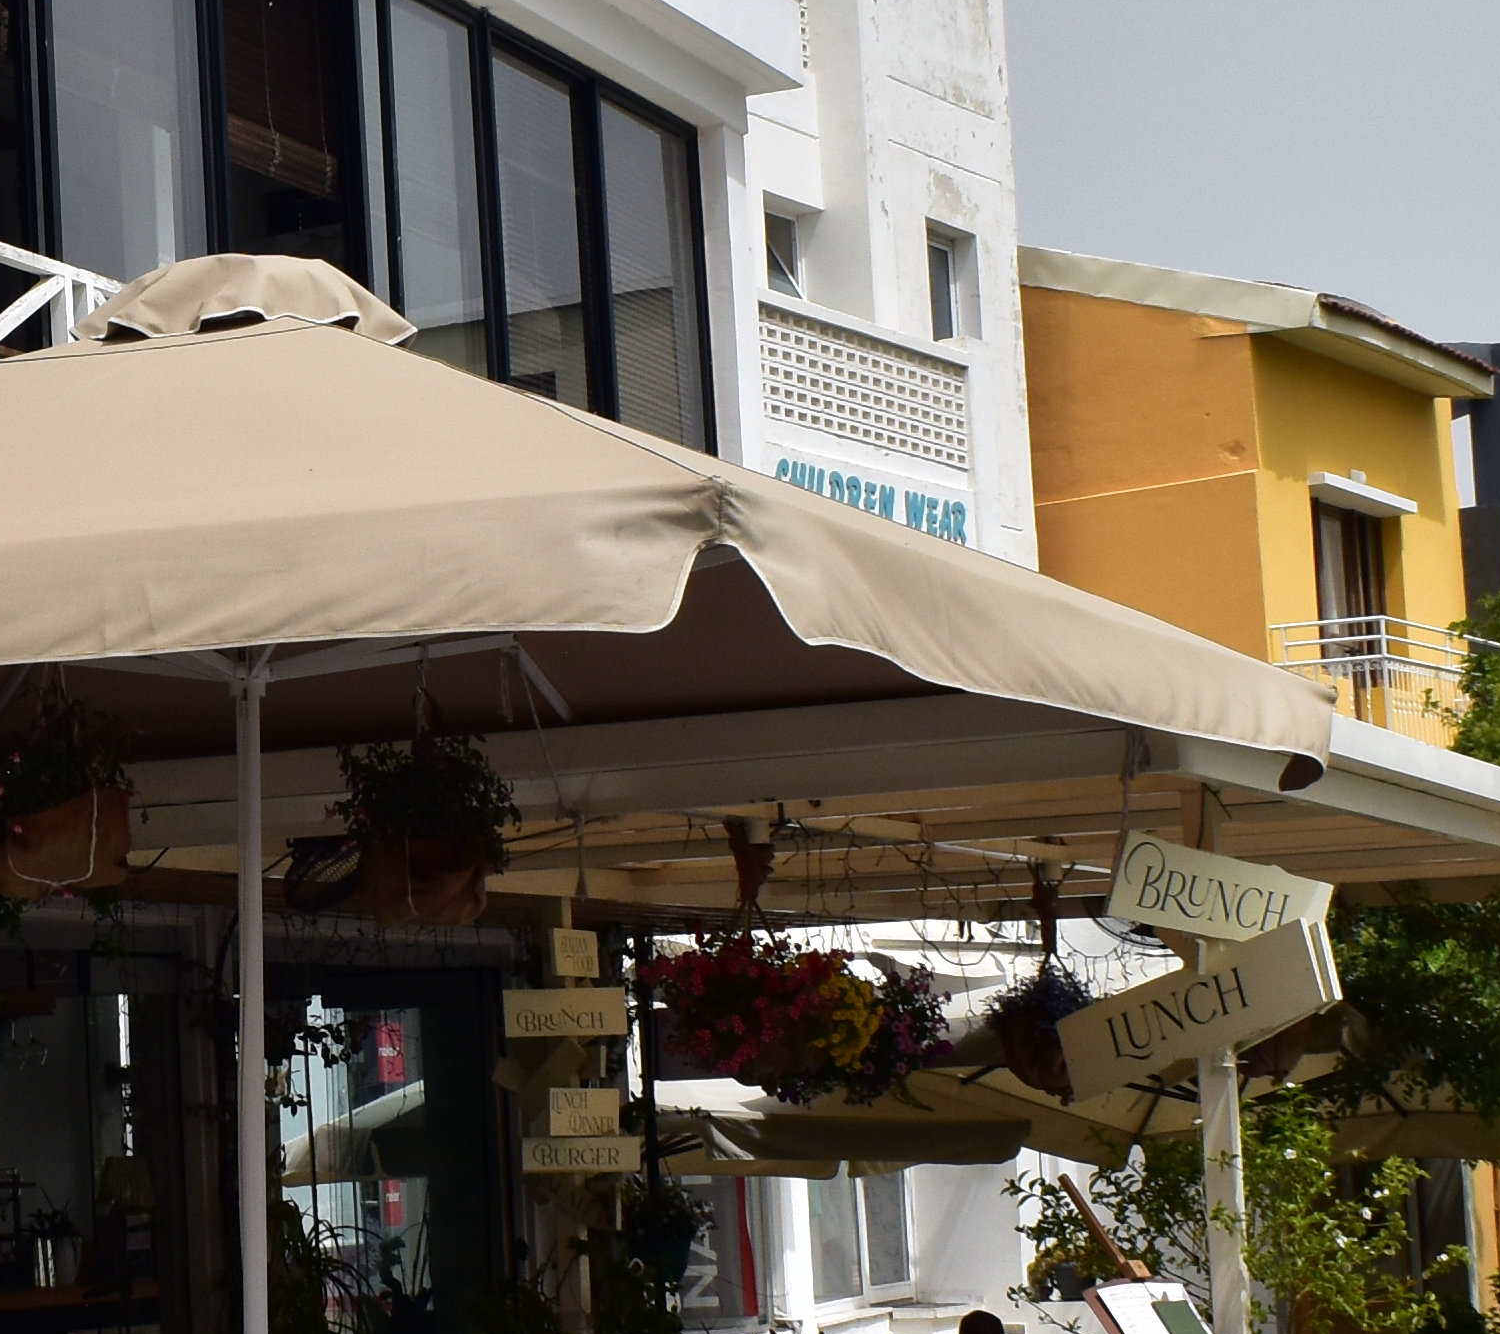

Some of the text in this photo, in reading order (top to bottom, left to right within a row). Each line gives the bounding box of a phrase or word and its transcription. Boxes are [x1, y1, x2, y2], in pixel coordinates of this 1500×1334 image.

[905, 490, 967, 545] WEAR
[1125, 841, 1290, 932] BRUNCH
[517, 1005, 604, 1033] BRUNCH
[1106, 968, 1249, 1060] LUNCH
[551, 1091, 588, 1114] LUNCH
[533, 1143, 620, 1167] BURGER
